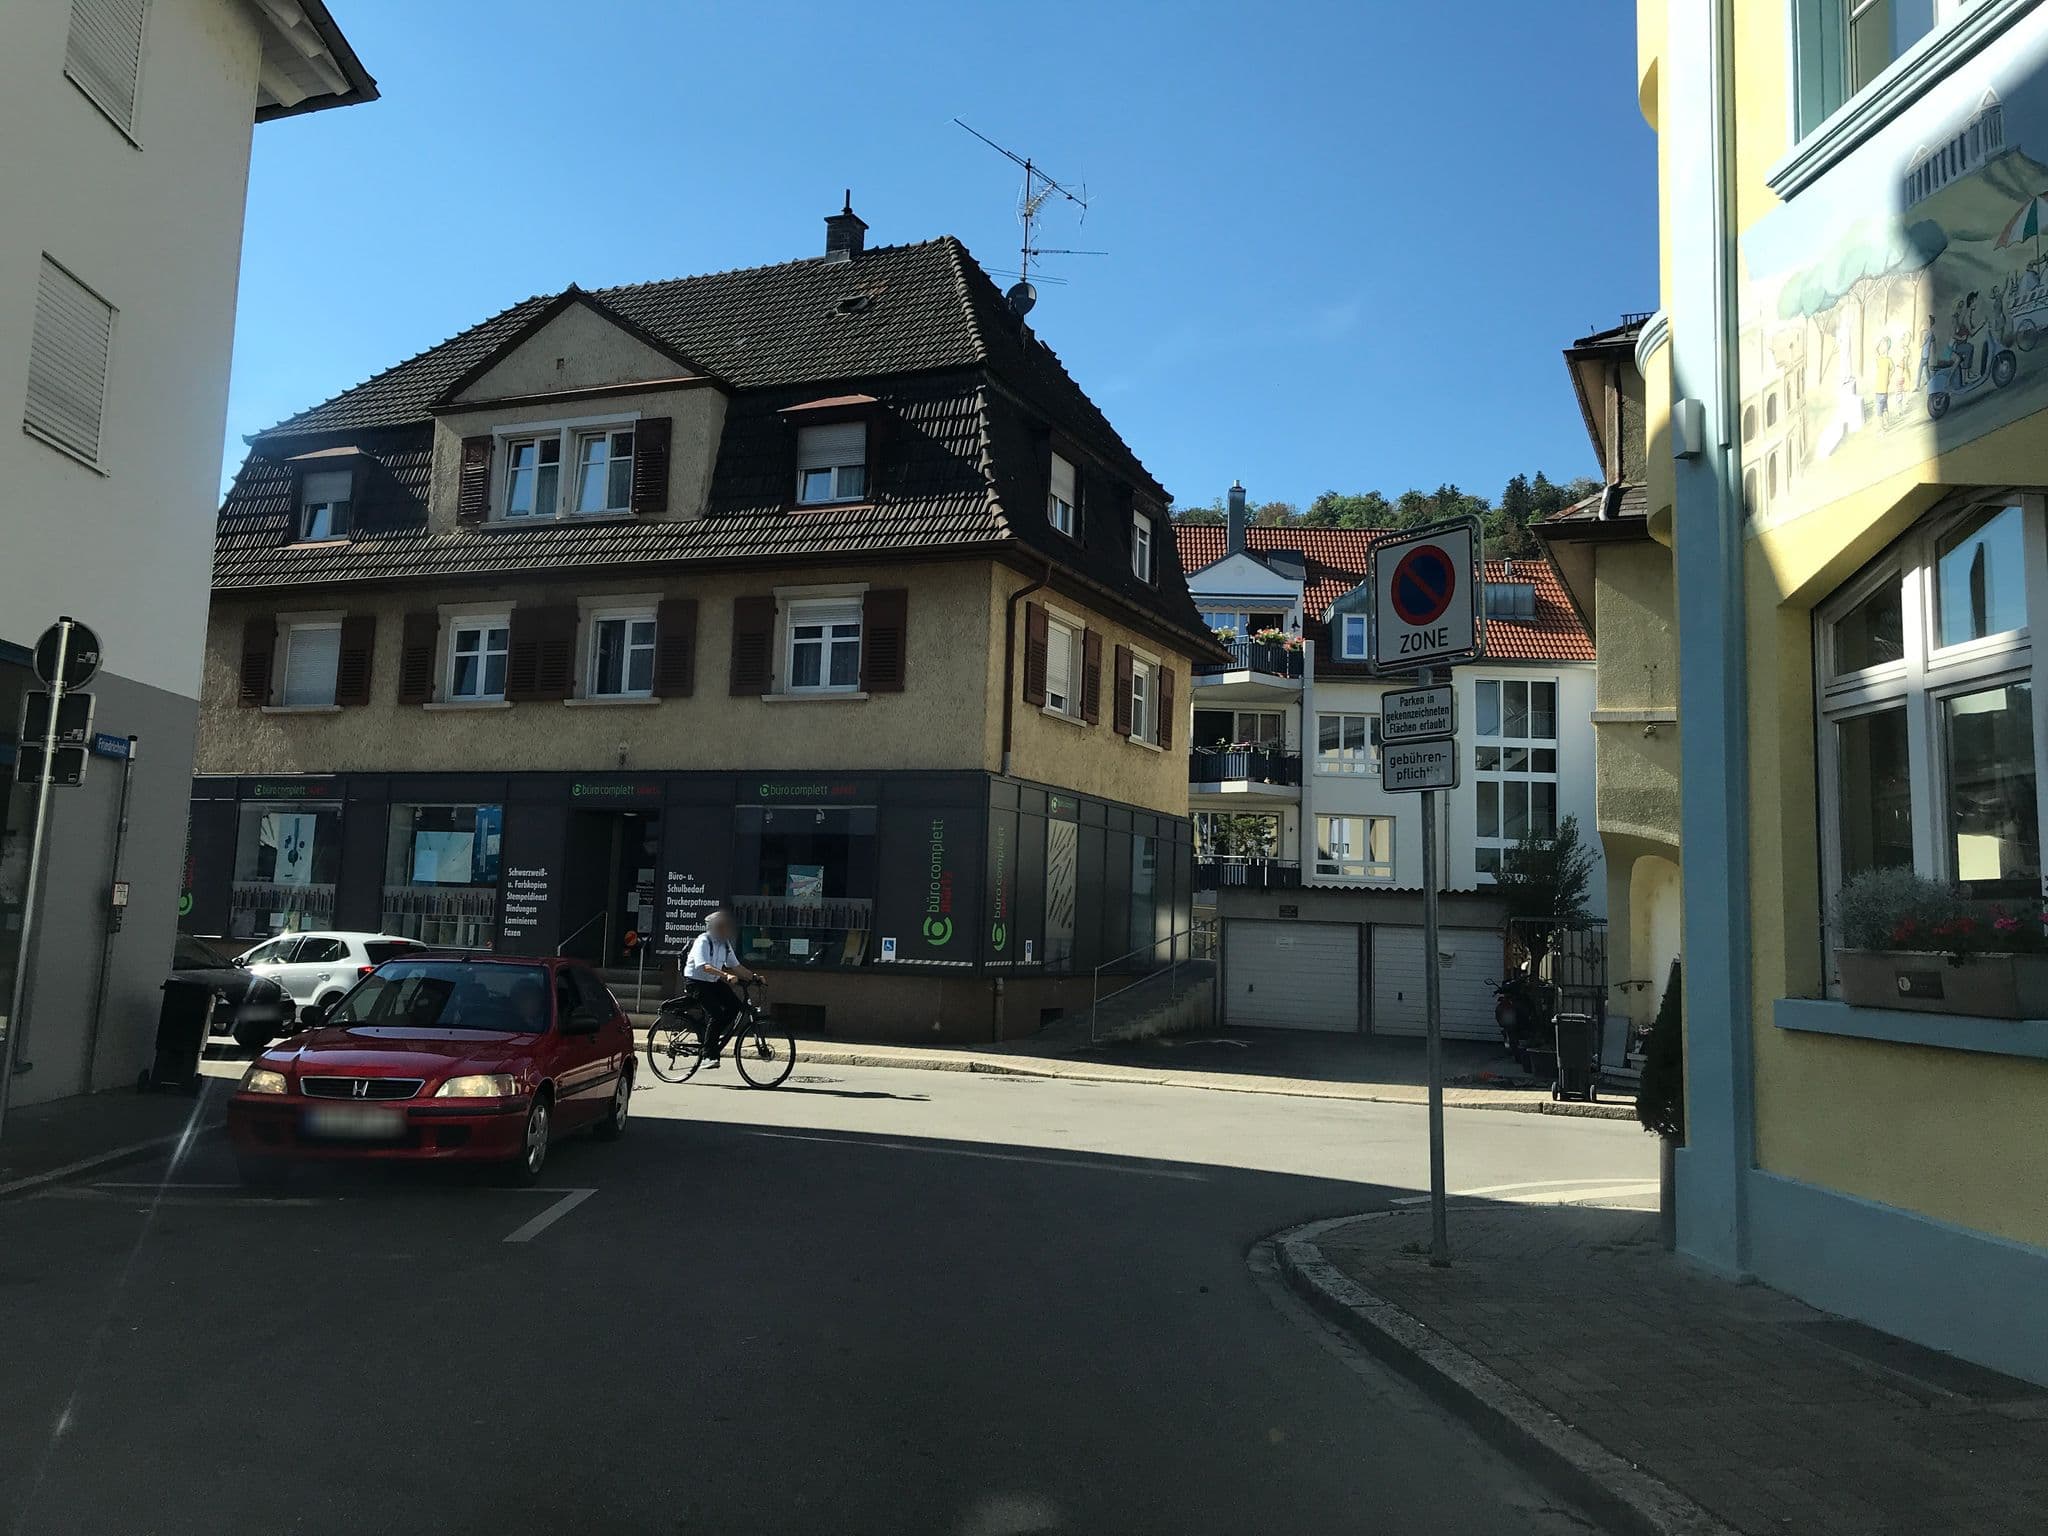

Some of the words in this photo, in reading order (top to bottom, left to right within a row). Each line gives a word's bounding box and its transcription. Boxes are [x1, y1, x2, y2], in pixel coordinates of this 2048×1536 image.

[1400, 627, 1449, 654] ZONE
[1400, 696, 1425, 707] Parken
[1427, 693, 1435, 704] in
[1386, 706, 1450, 723] gekennzeichneten
[1389, 722, 1417, 734] Flächen
[1420, 718, 1446, 730] erlaubt
[1390, 752, 1448, 768] gebühren-
[929, 819, 945, 880] complett
[668, 871, 687, 881] Büro-
[514, 879, 548, 891] Farbkopien
[667, 884, 705, 894] Schulbedarf
[666, 896, 720, 908] Druckerpatronen
[926, 882, 941, 913] büro
[505, 903, 537, 915] Bindungen
[665, 909, 679, 918] und
[680, 909, 697, 919] Toner
[505, 915, 538, 925] Laminieren
